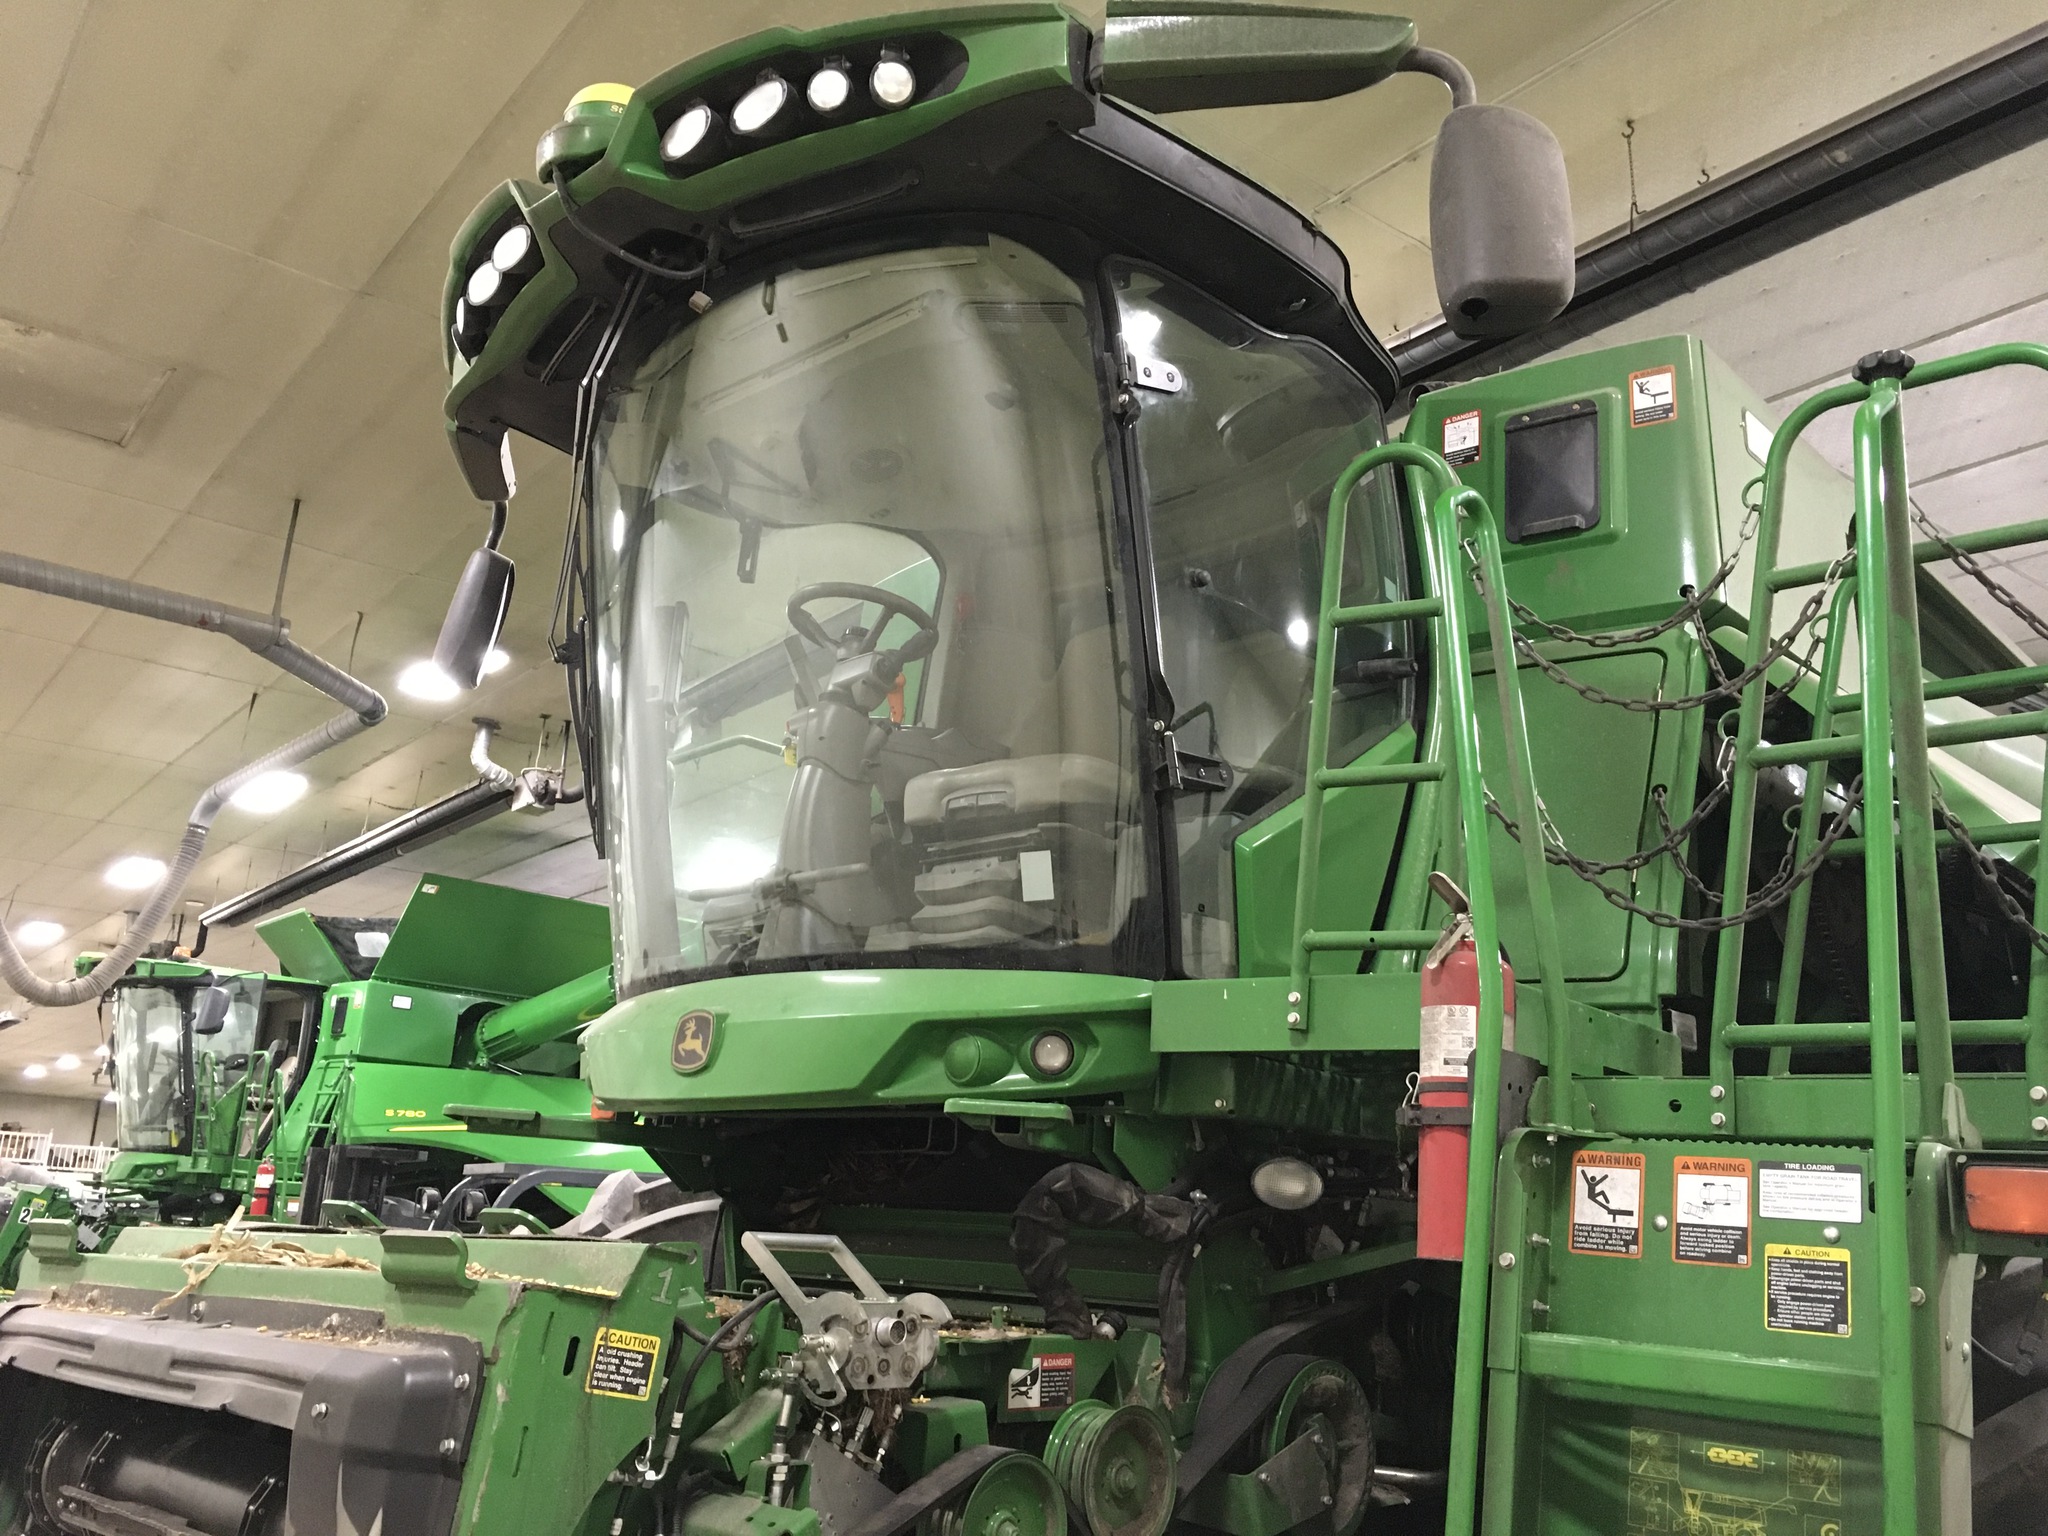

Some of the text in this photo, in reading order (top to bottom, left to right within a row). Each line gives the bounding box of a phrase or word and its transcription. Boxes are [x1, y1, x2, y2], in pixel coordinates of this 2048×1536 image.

[1452, 411, 1477, 422] DANGER
[1588, 1154, 1641, 1166] WARNING
[1693, 1162, 1745, 1172] WARNING
[20, 1209, 30, 1223] 2
[651, 1267, 673, 1304] 1
[609, 1333, 656, 1350] CAUTION
[599, 1347, 642, 1361] Aoid crushing
[624, 1359, 644, 1368] Header
[1049, 1358, 1072, 1366] DANGER
[620, 1367, 633, 1376] Stay
[598, 1381, 622, 1390] running.
[626, 1377, 645, 1385] engine
